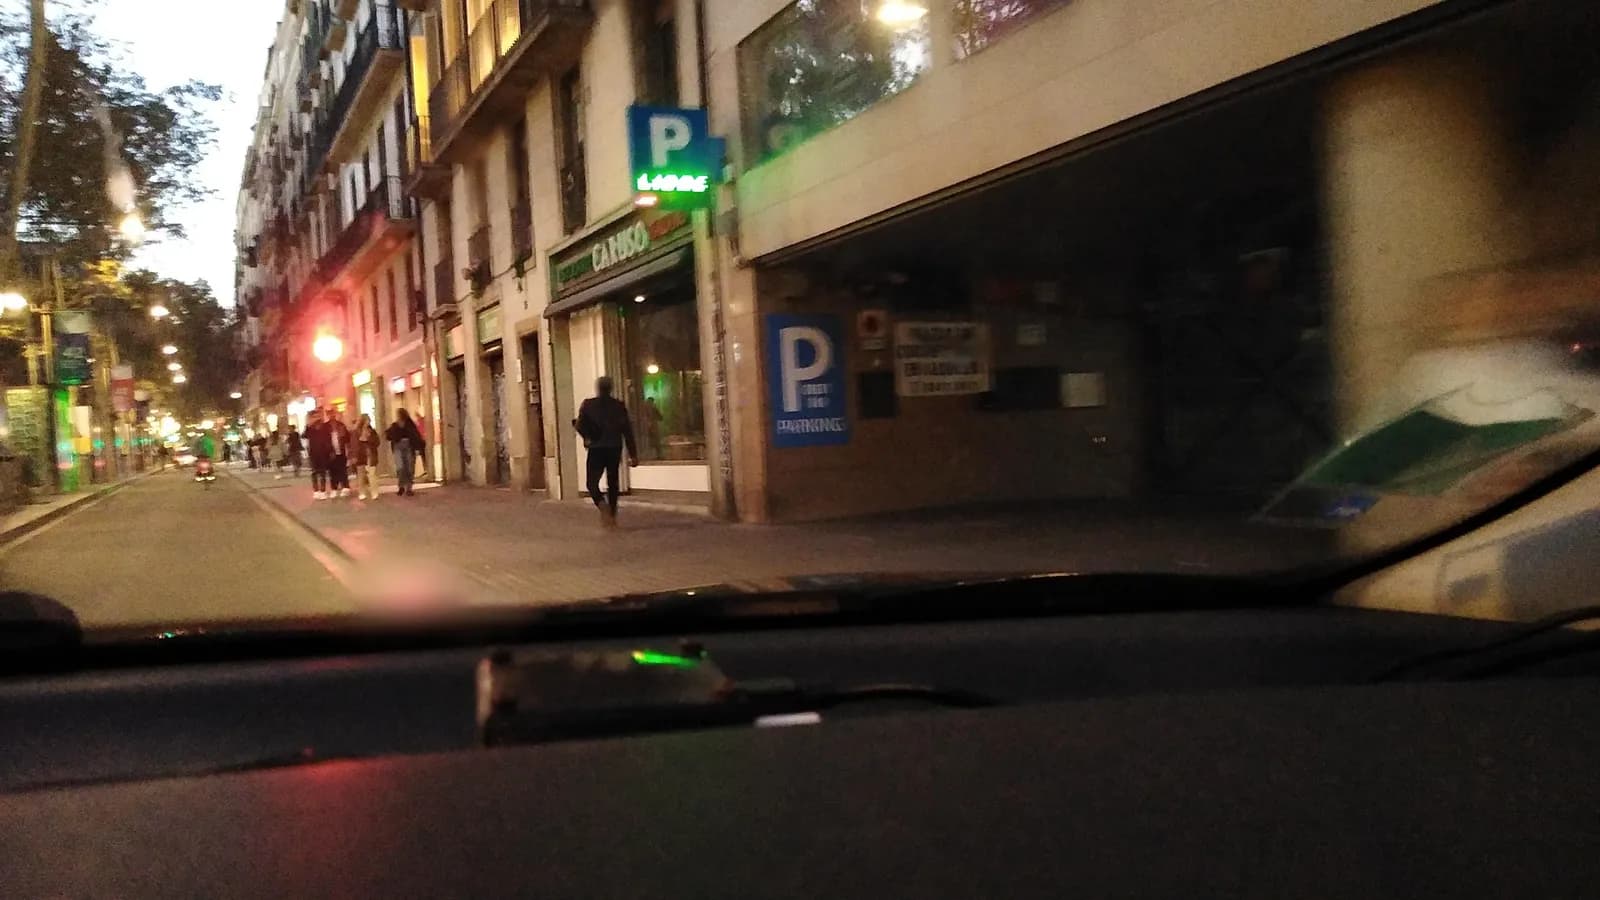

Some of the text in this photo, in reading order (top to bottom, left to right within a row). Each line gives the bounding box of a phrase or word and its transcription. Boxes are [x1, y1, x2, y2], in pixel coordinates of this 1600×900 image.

[650, 115, 692, 168] P
[592, 220, 650, 272] CARUSO
[779, 326, 834, 412] P
